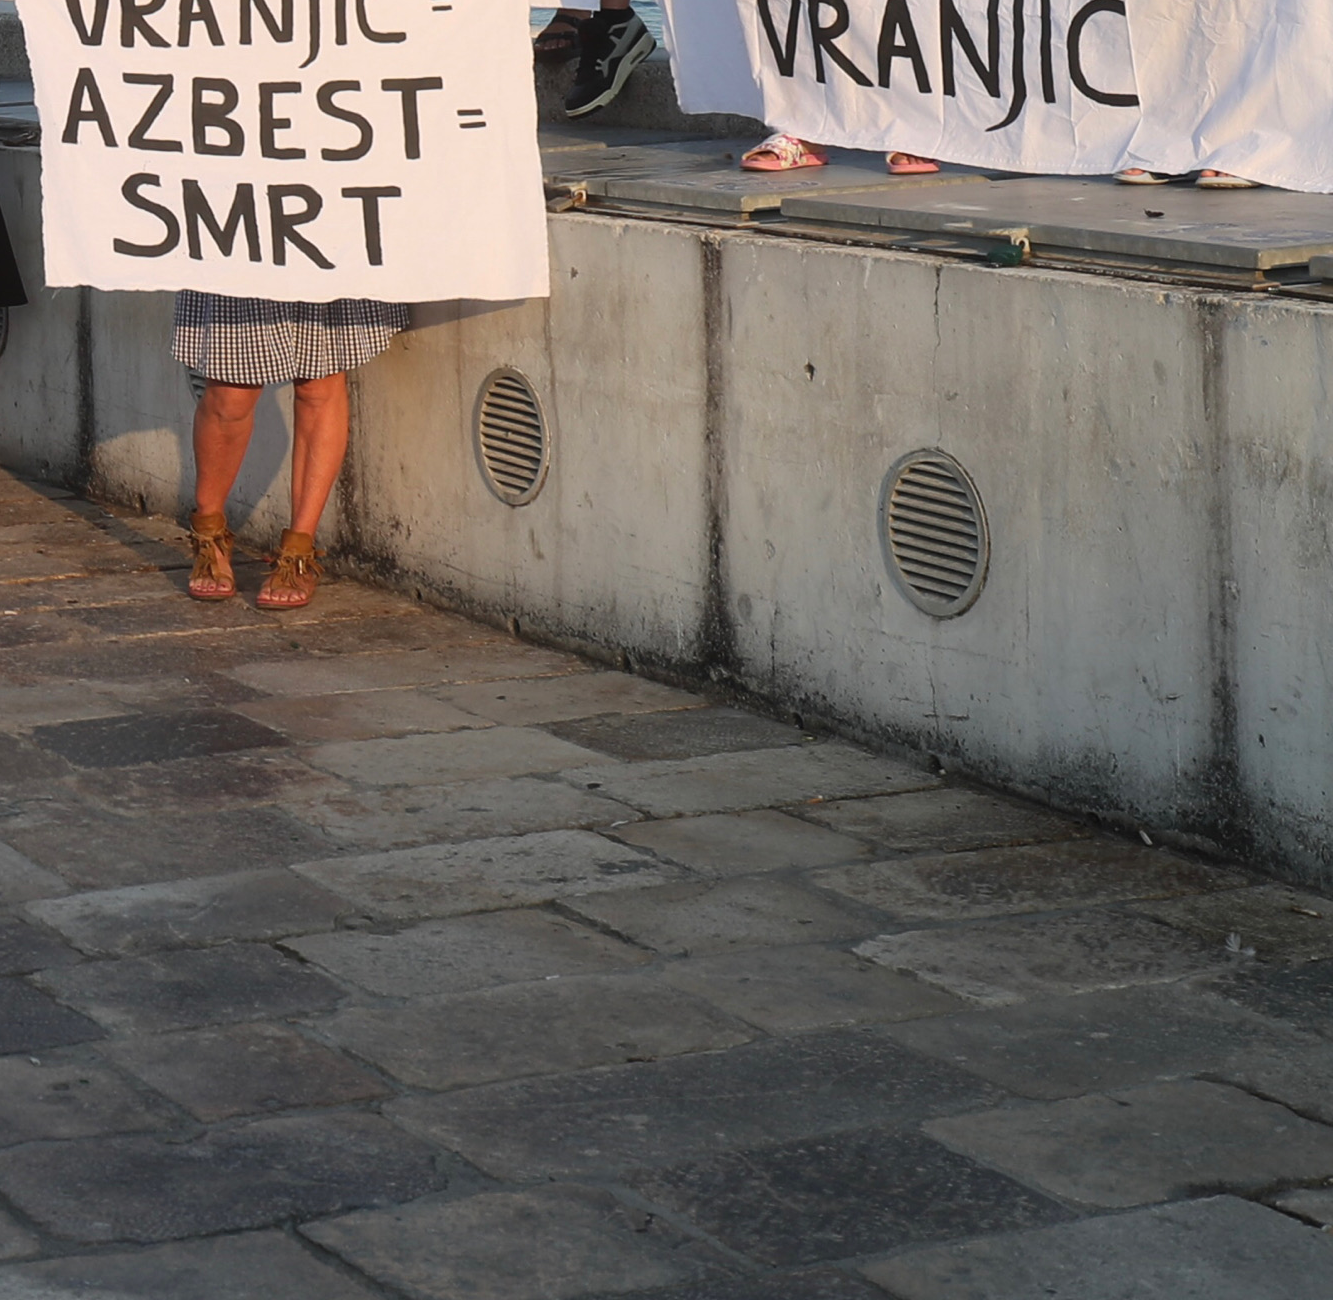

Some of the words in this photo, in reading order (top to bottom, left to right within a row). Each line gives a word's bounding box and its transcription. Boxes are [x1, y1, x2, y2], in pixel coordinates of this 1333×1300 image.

[62, 67, 443, 161] AZBEST
[456, 108, 487, 128] =
[113, 173, 401, 269] SMRT
